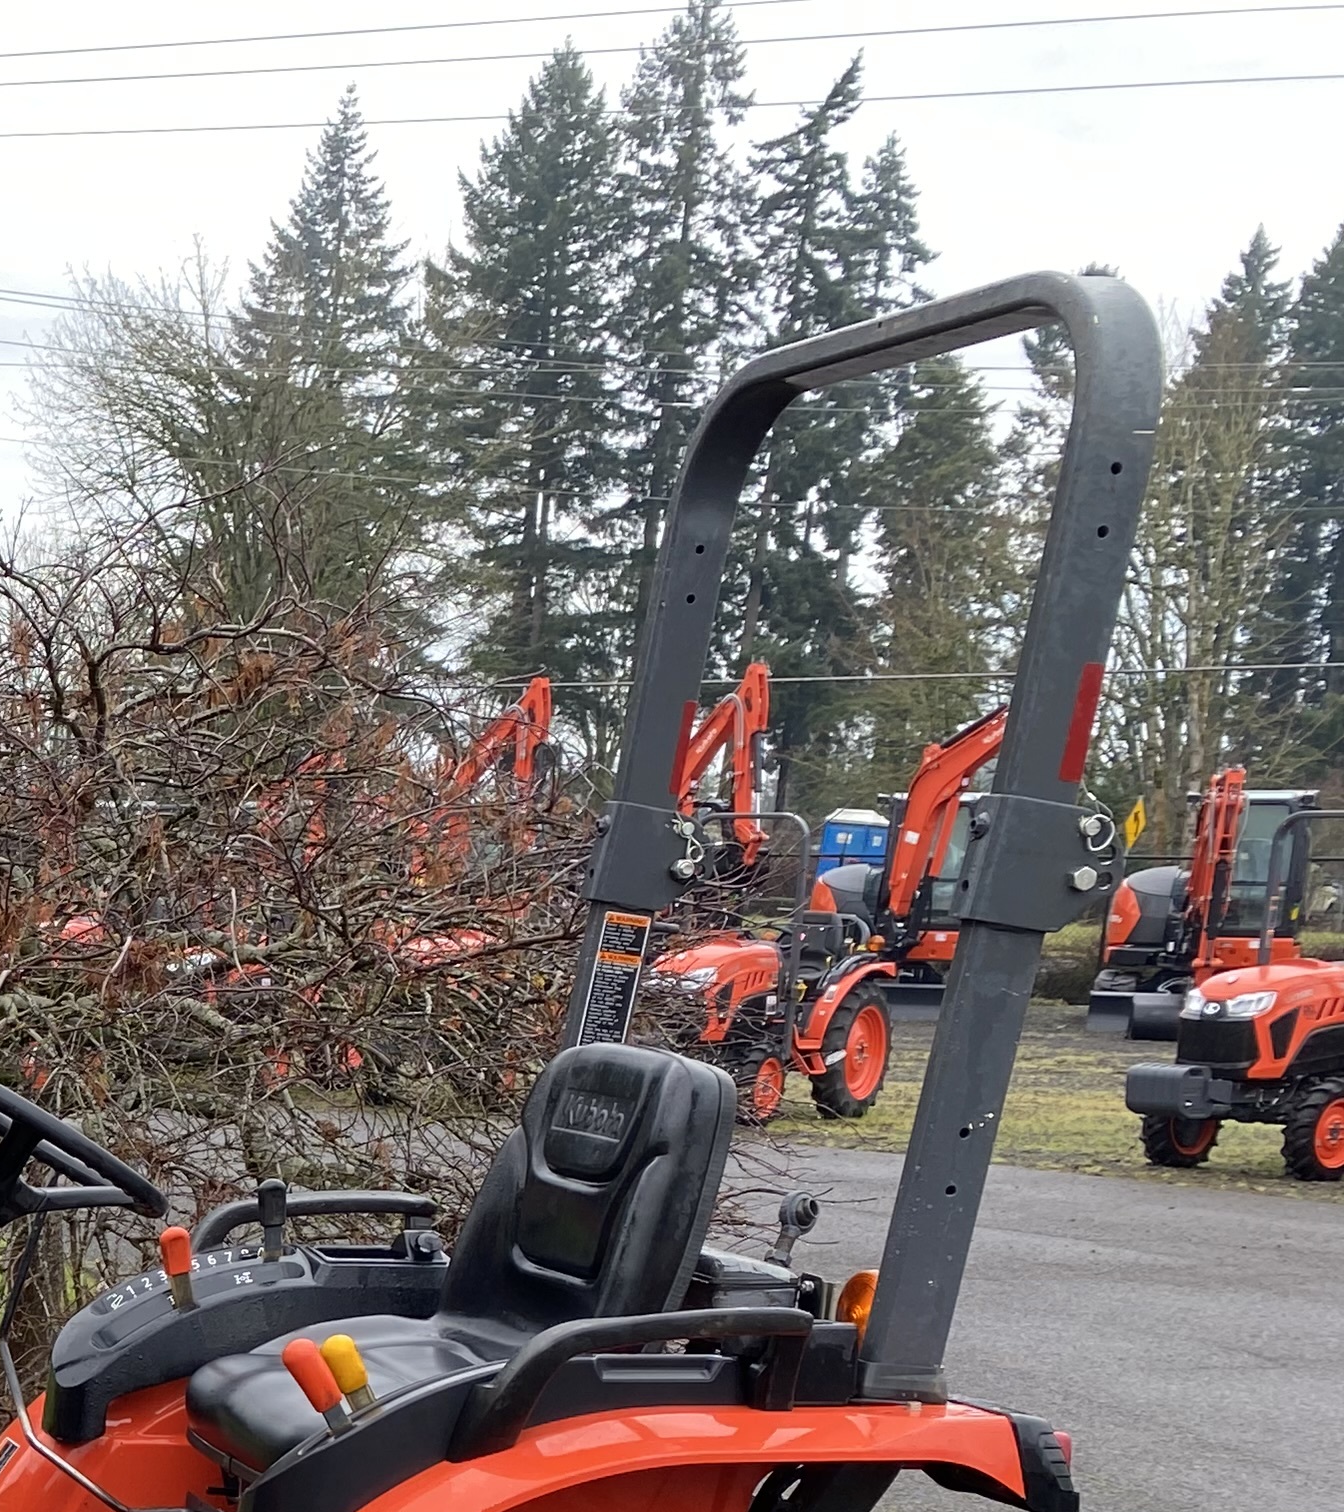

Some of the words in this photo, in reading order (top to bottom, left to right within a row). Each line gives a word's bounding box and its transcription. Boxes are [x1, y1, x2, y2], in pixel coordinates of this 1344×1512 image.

[126, 1285, 135, 1297] 1
[141, 1277, 152, 1289] 2
[191, 1259, 200, 1270] 5
[208, 1254, 217, 1266] 6
[224, 1251, 233, 1262] 7
